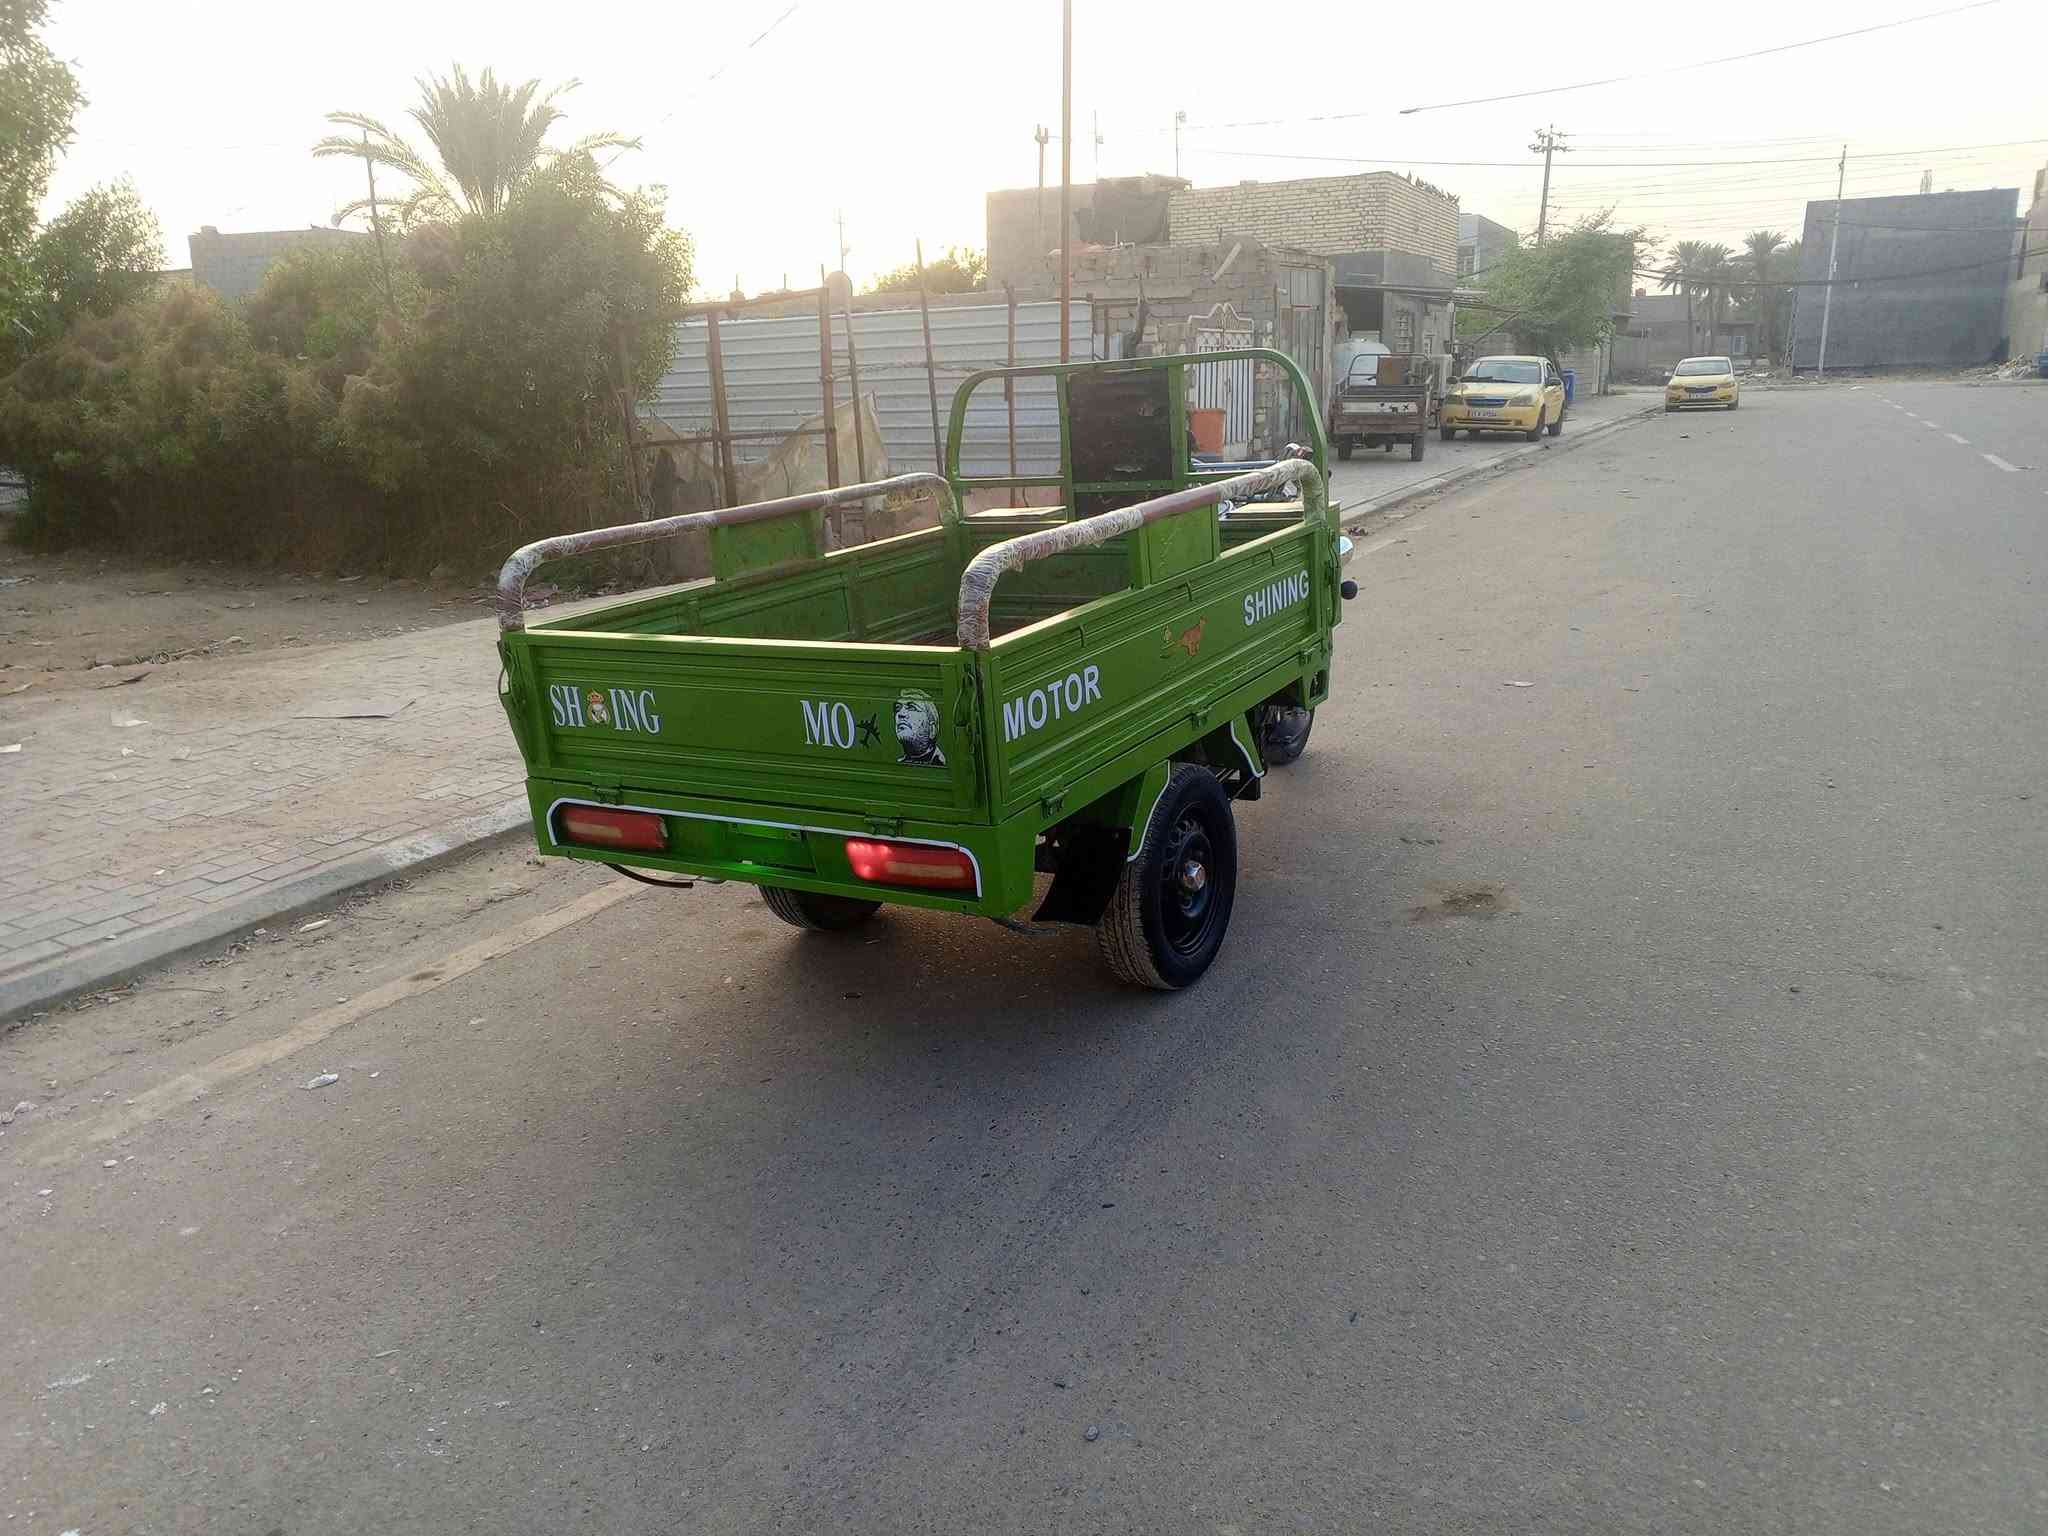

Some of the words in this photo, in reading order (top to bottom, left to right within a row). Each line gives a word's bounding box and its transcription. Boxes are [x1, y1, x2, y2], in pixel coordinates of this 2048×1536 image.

[1003, 665, 1102, 743] MOTOR
[1244, 569, 1309, 626] SHINING
[800, 700, 855, 749] MO
